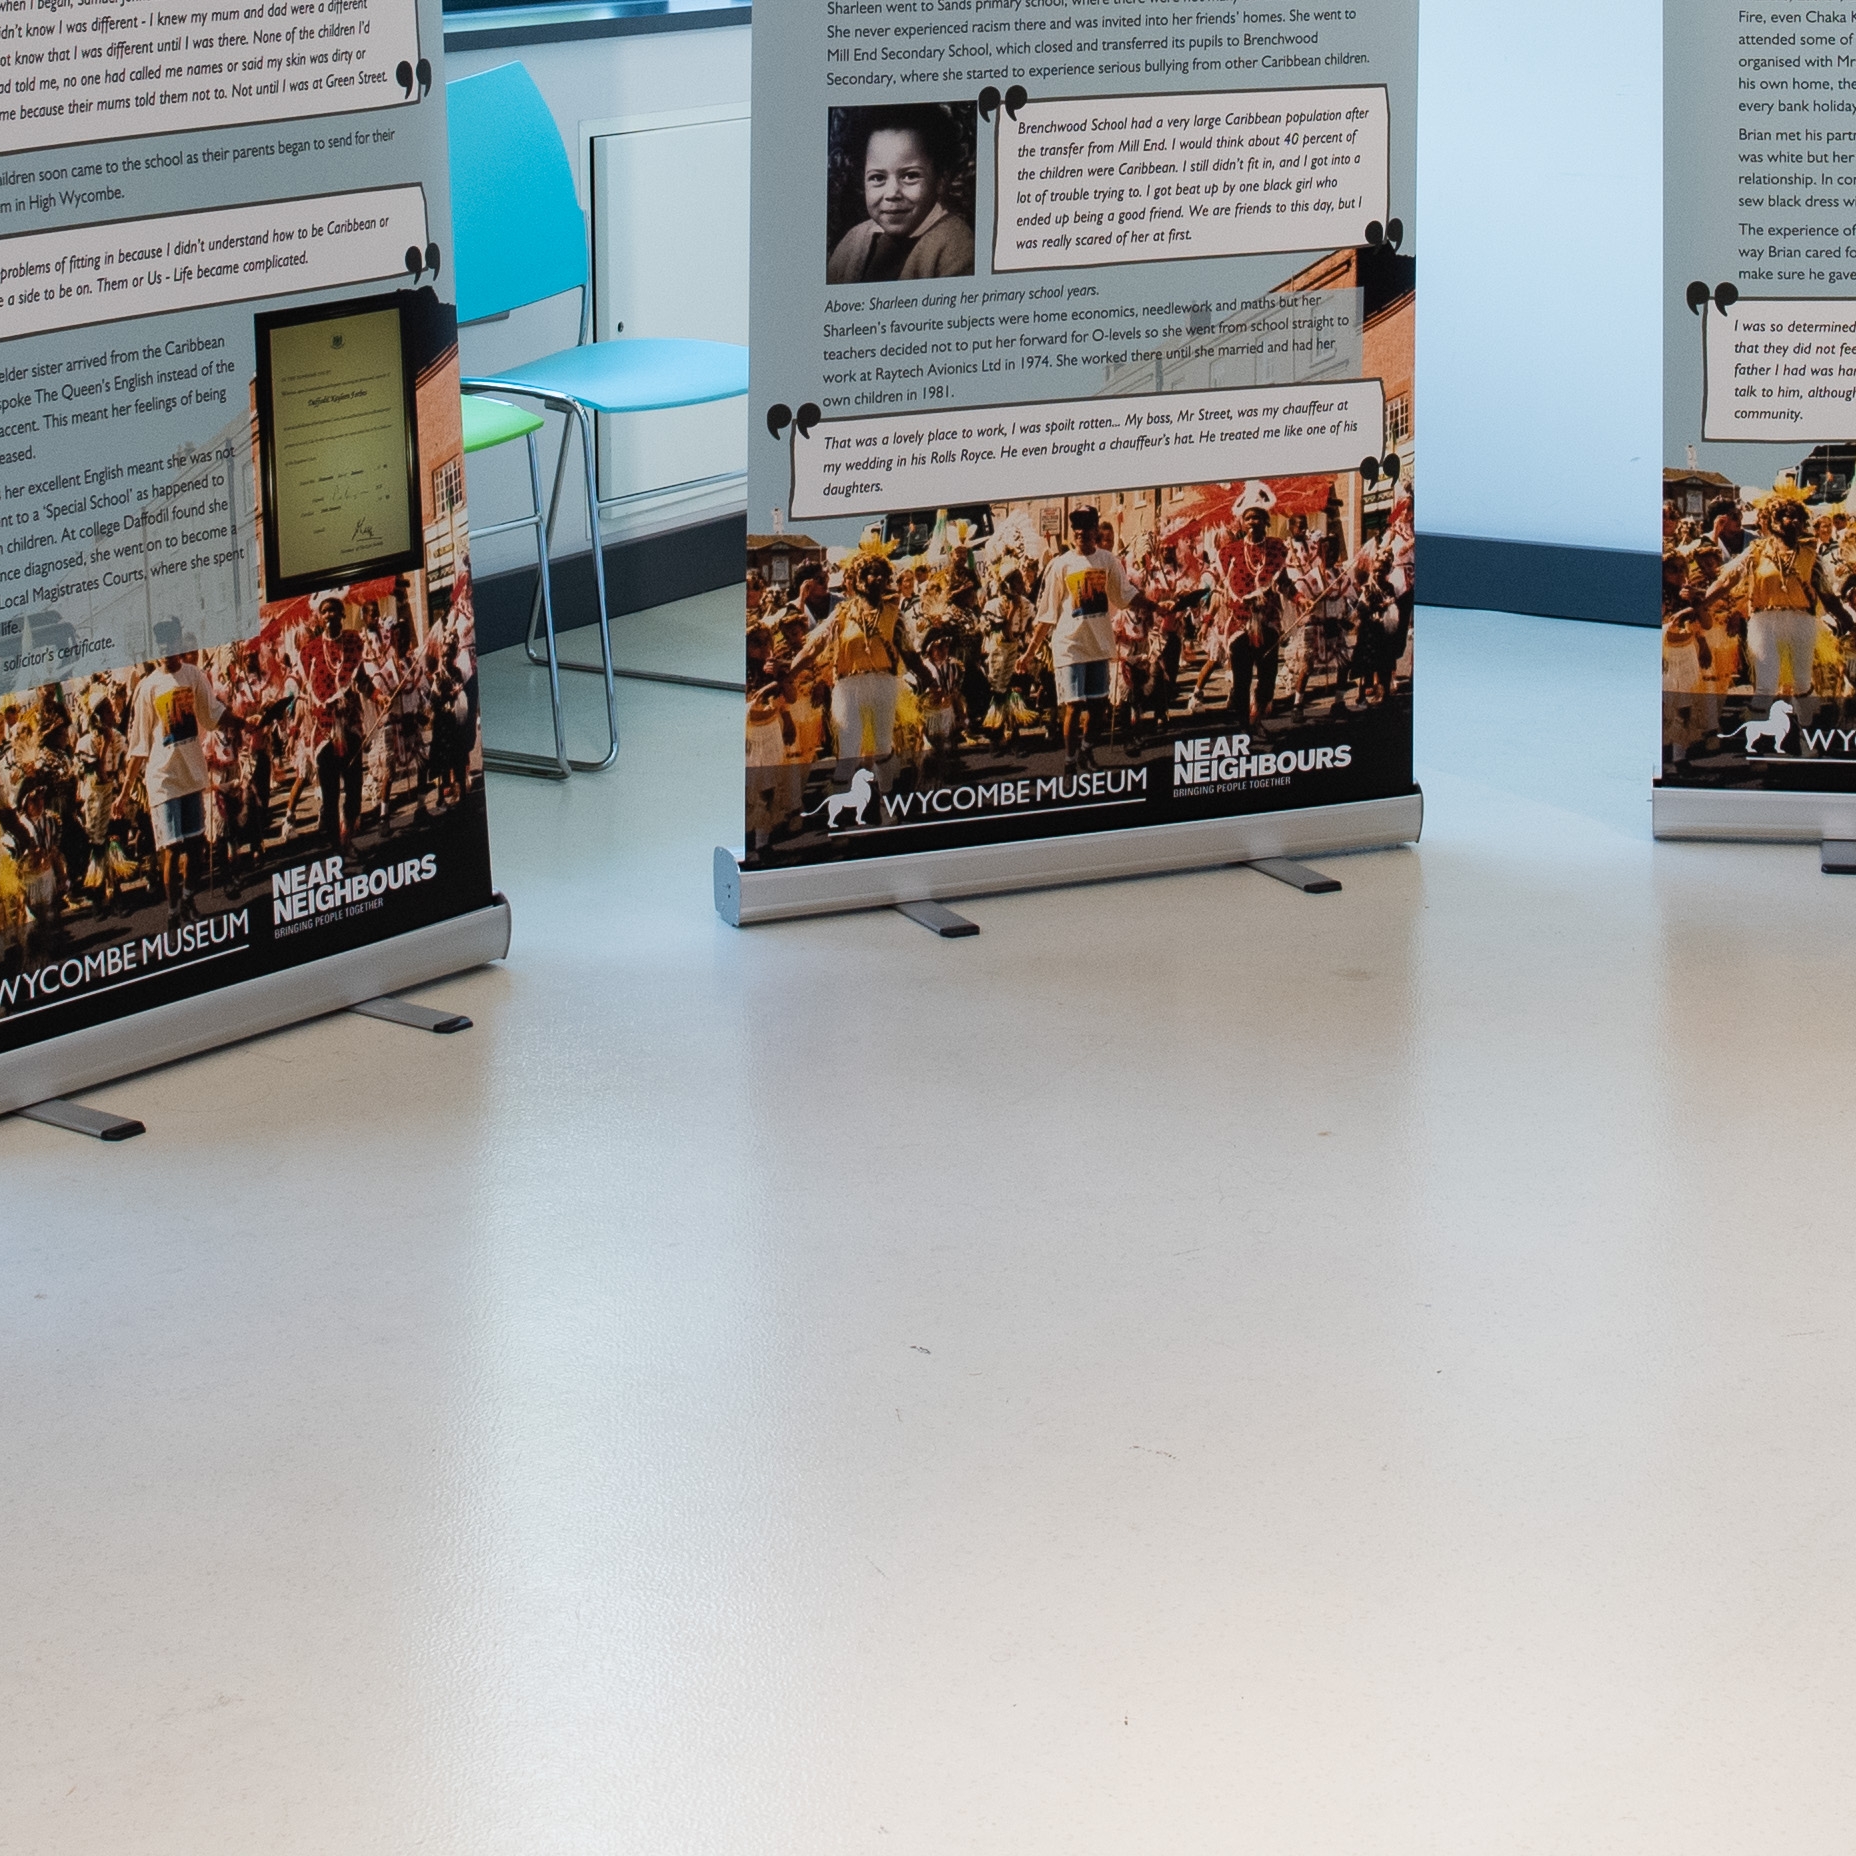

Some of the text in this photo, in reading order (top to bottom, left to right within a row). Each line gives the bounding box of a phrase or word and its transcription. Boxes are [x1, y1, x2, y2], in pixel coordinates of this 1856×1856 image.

[1173, 744, 1352, 786] NEIGHBOURS
[1174, 733, 1251, 763] NEAR
[882, 767, 1147, 818] WYCOMBE MUSEUM
[1173, 776, 1291, 798] BRINGING PEOPLE TOGETHER
[271, 855, 344, 899] NEAR
[273, 853, 437, 925] NEIGHBOURS
[141, 908, 249, 965] MUSEUM
[274, 897, 384, 940] BRINGING PEOPLE TOGETHER
